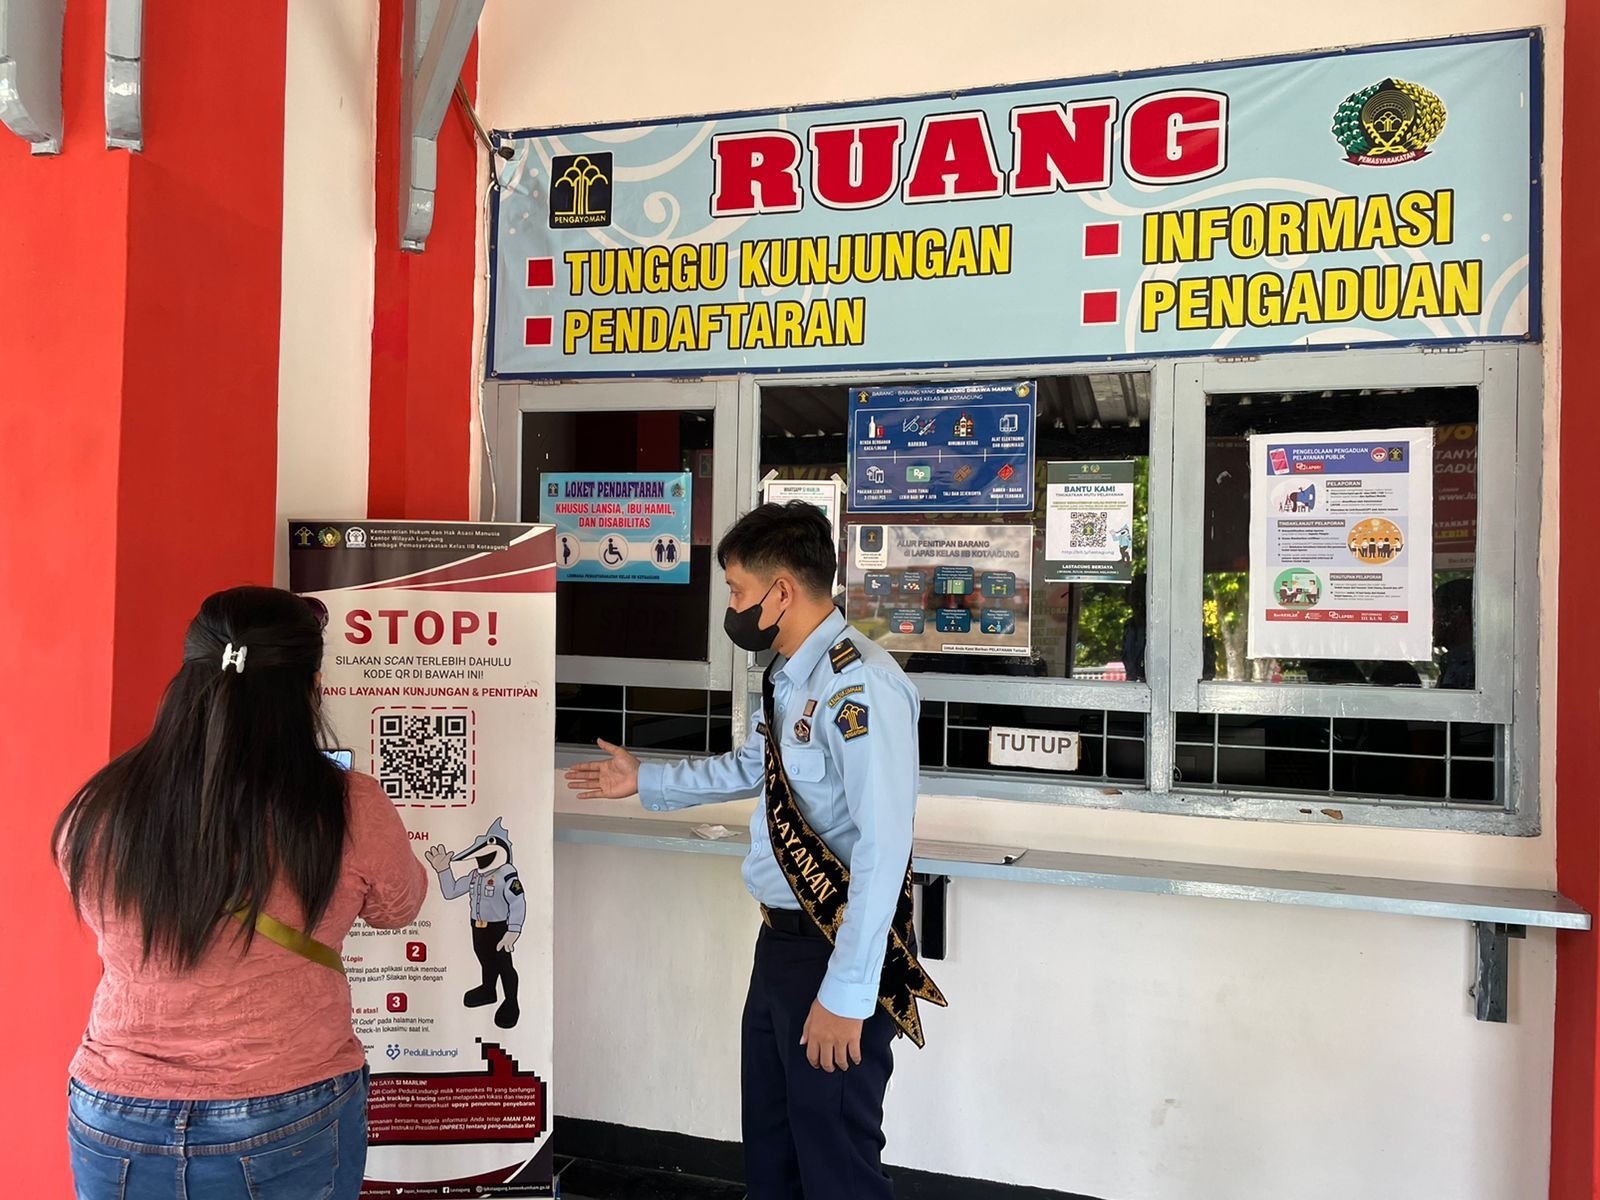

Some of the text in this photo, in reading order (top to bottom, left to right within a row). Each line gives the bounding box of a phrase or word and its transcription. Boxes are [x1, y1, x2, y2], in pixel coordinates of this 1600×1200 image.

[711, 88, 1230, 218] RUANG
[1358, 152, 1416, 165] PEMASYARAKATAN
[554, 215, 606, 224] PENGAYOMAN
[1142, 188, 1454, 265] INFORMASI
[563, 223, 1013, 296] TUNGGU KUNJUNGAN
[1140, 259, 1483, 333] PENGADUAN
[563, 297, 866, 356] PENDAFTARAN
[913, 468, 925, 480] Rp
[565, 481, 665, 498] LOKET PENDAFTARAN
[1064, 485, 1092, 493] BANTU
[555, 503, 675, 515] KHUSUS LANSIA, IBU HAMIL,
[578, 517, 651, 529] DAN DISABILITAS
[897, 540, 990, 548] ALUR PENITIPAN BARANG
[911, 550, 935, 558] LAPAS
[936, 550, 960, 558] KELAS
[971, 550, 1019, 559] KOTAAGUNG
[344, 609, 498, 646] STOP!
[335, 655, 512, 667] SILAKAN SCAN TERLEBIH DAHULU
[363, 669, 484, 679] KODE QR DI BAWAH INI!
[349, 686, 400, 696] LAYANAN
[402, 687, 469, 697] KUNJUNGAN
[472, 687, 479, 697] &
[481, 687, 538, 697] PENITIPAN
[996, 733, 1072, 755] TUTUP
[773, 800, 838, 904] LAYANAN
[411, 945, 420, 957] 2
[380, 966, 403, 974] aplikasi
[420, 965, 447, 973] membuat
[408, 974, 421, 982] login
[392, 996, 400, 1007] 3
[382, 1025, 407, 1033] lokasimu
[403, 1048, 458, 1058] PeduliLindungi
[386, 1095, 410, 1103] tracking
